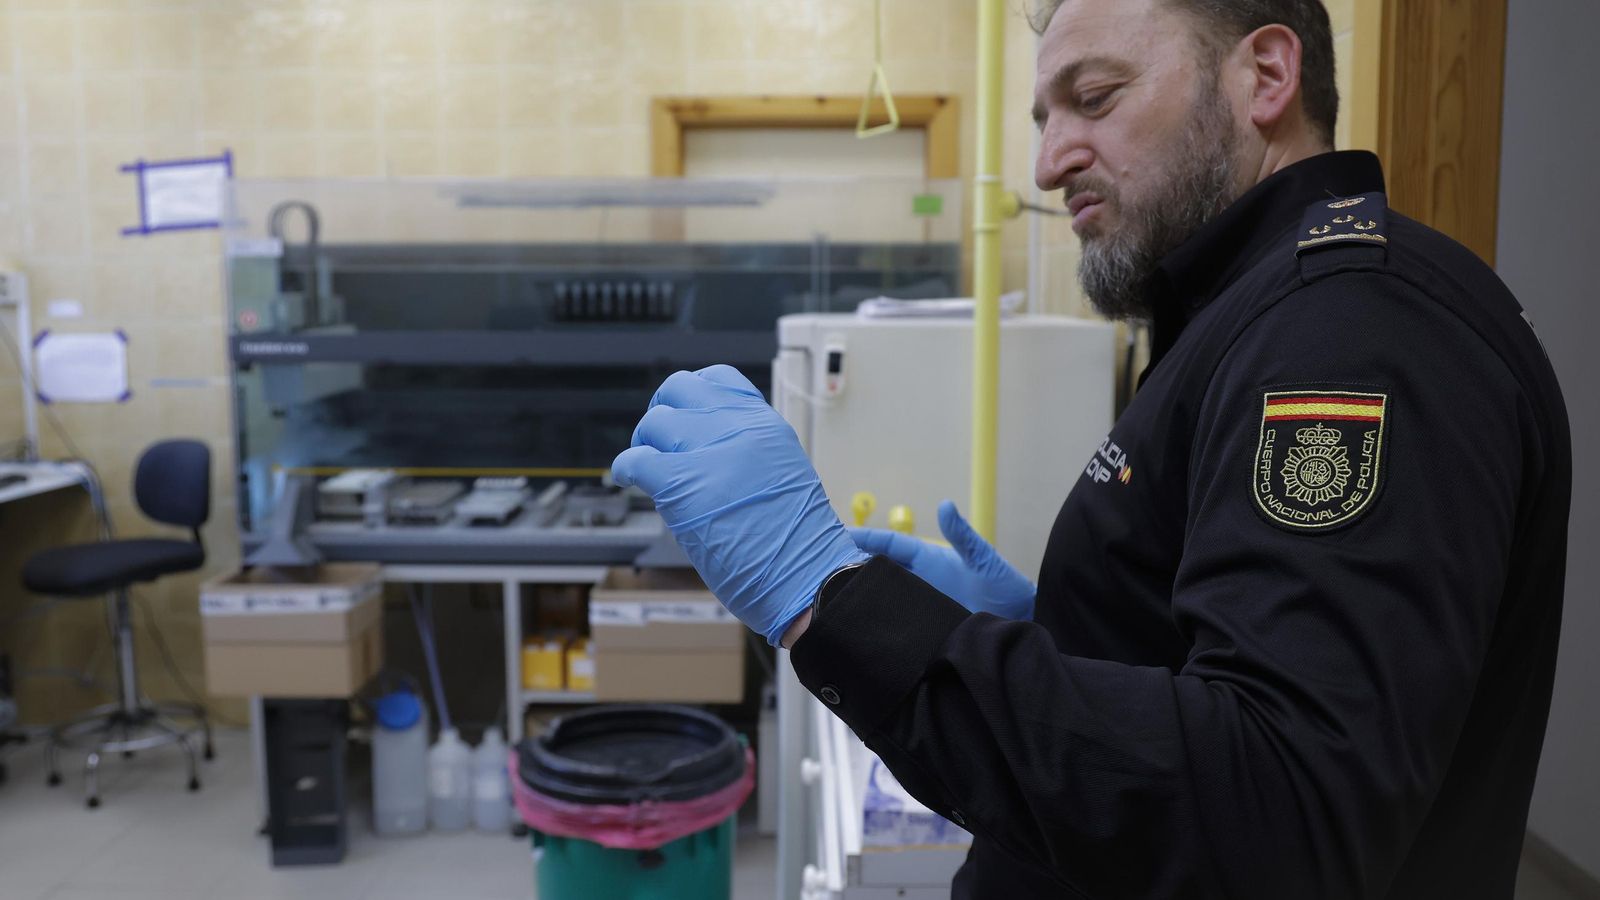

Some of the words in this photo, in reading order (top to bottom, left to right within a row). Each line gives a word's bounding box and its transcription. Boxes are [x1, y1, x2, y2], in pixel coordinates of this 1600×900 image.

[1085, 458, 1111, 483] CNP
[1260, 429, 1276, 494] CUERPO
[1357, 429, 1377, 490] POLICIA
[1263, 494, 1341, 521] NACIONAL
[1341, 490, 1363, 511] DE
